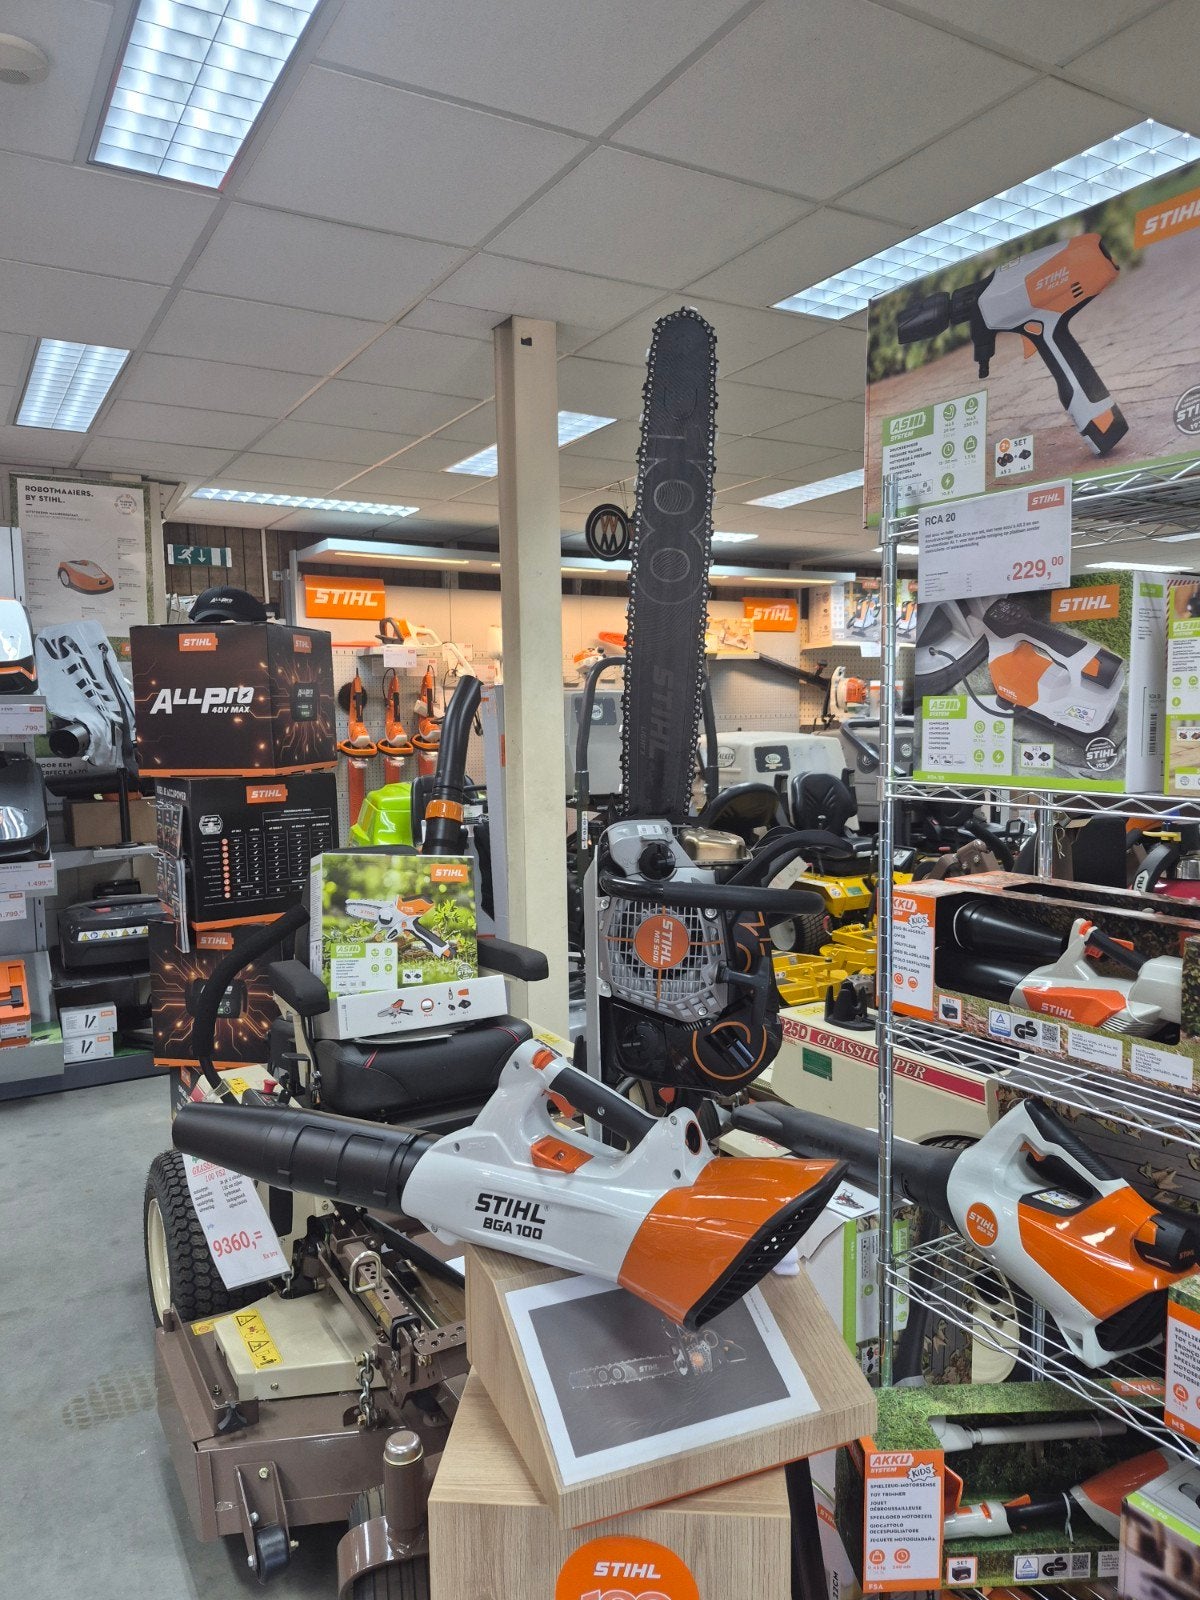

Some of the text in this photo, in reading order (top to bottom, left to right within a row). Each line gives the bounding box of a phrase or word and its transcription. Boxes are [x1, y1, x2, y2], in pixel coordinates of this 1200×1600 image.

[1036, 267, 1069, 290] STIHL
[25, 486, 93, 499] ROBOTMAAIERS.
[1031, 493, 1061, 506] STIHL
[925, 513, 956, 527] RCA 20
[1052, 556, 1064, 566] 00
[1012, 559, 1052, 581] 229,
[315, 590, 378, 606] STIHL
[1058, 595, 1111, 613] STIHL
[754, 606, 794, 622] STIHL
[183, 638, 213, 647] STIHL
[294, 640, 311, 649] STIHL
[999, 685, 1017, 697] STIHL
[211, 705, 251, 714] 40V MAX
[649, 665, 673, 758] STIHL
[1086, 749, 1118, 761] STIHL
[251, 790, 282, 799] STIHL
[435, 868, 465, 877] STIHL
[911, 916, 927, 924] KIDS
[200, 937, 229, 945] STIHL
[660, 918, 674, 966] STIHL
[1041, 1003, 1075, 1020] STIHL
[1014, 1021, 1038, 1039] GS
[475, 1192, 546, 1225] STIHL
[483, 1217, 543, 1240] BGA 100
[969, 1212, 996, 1233] STIHL
[1179, 1250, 1195, 1258] STIHL
[1174, 1326, 1200, 1343] SPIELZE
[1174, 1333, 1186, 1343] TOY
[1174, 1341, 1200, 1358] TRONCO
[1121, 1383, 1161, 1393] STIHL
[1171, 1418, 1185, 1432] MS
[872, 1455, 910, 1467] AKKU
[870, 1467, 897, 1475] SYSTEM
[912, 1466, 932, 1479] KIDS
[820, 1510, 836, 1527] STIH
[593, 1561, 662, 1579] STIHL
[1042, 1556, 1067, 1577] GS
